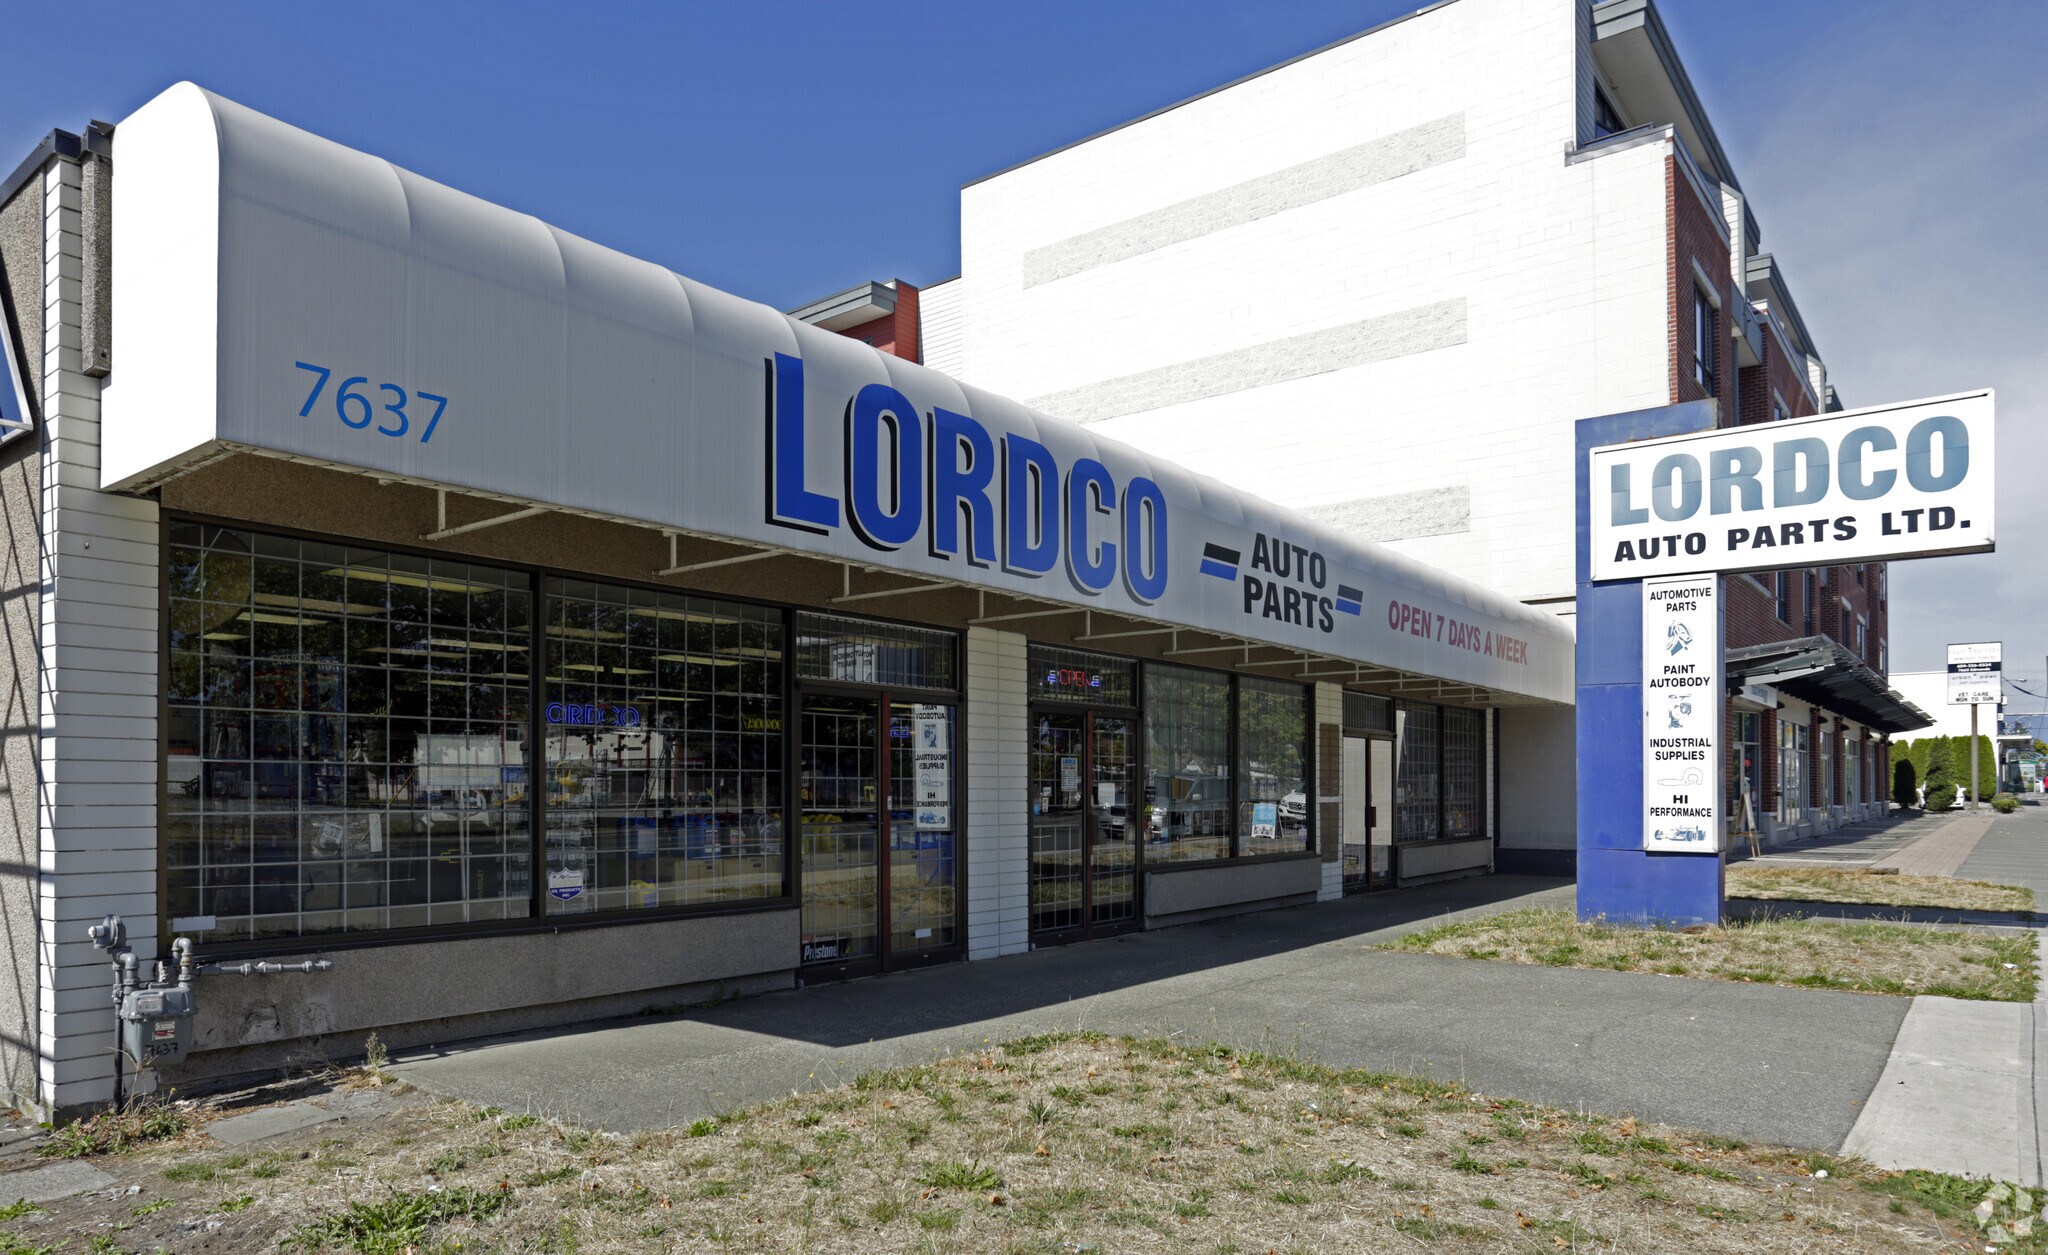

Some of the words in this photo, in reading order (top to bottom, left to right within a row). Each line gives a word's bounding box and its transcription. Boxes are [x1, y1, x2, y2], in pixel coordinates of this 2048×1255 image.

[295, 361, 448, 443] 7637
[765, 351, 1168, 606] LORDCO
[1611, 416, 1970, 528] LORDCO
[1614, 532, 1707, 562] AUTO
[1727, 516, 1858, 550] PARTS
[1881, 506, 1971, 536] LTD.
[1251, 532, 1327, 590] AUTO
[1650, 588, 1712, 601] AUTOMOTIVE
[1243, 574, 1334, 634] PARTS
[1666, 601, 1697, 612] PARTS
[1388, 600, 1432, 640] OPEN
[1436, 615, 1445, 642] 7
[1448, 618, 1481, 653] DAYS
[1484, 630, 1492, 656] A
[1495, 633, 1528, 665] WEEK
[1663, 664, 1696, 675] PAINT
[1650, 677, 1711, 688] AUTOBODY
[1650, 738, 1711, 748] INDUSTRIAL
[1655, 750, 1705, 761] SUPPLIES
[1673, 794, 1689, 804] HI
[1650, 807, 1713, 818] PERFORMANCE
[145, 1042, 179, 1057] 7637
